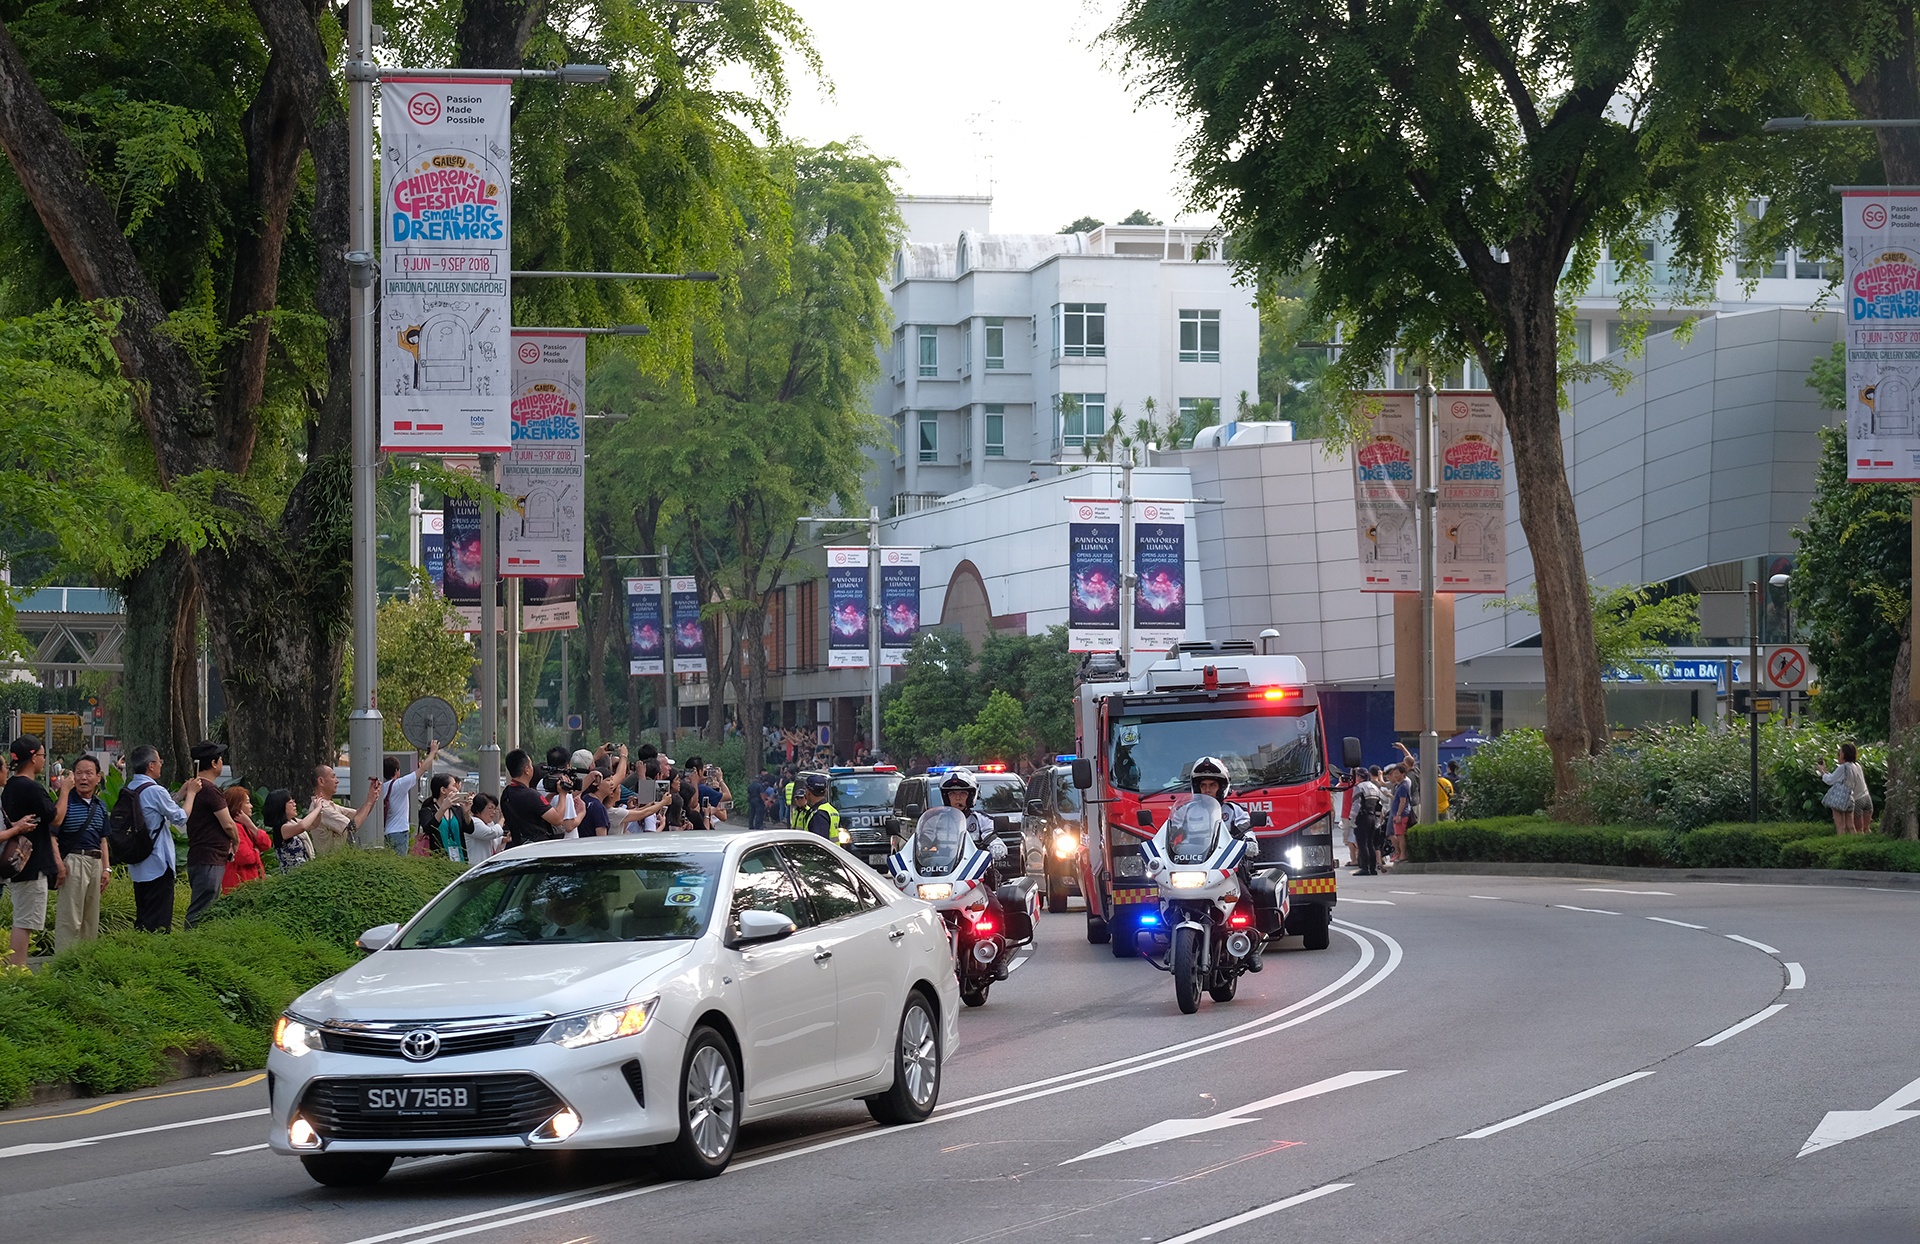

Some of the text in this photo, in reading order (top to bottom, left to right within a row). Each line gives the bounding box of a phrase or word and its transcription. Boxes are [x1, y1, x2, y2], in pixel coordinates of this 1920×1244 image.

[447, 95, 482, 104] Passion
[413, 102, 437, 116] SG
[447, 106, 472, 114] Made
[447, 116, 485, 124] Possible
[463, 204, 499, 222] BIG
[1866, 211, 1884, 222] SG
[403, 257, 490, 271] 9 JUN 9 SEP 2018
[389, 282, 503, 293] NATIONAL GALLERY SINGAPORE
[1905, 290, 1920, 305] BI
[1861, 332, 1866, 342] 9
[1867, 332, 1882, 343] JUN
[1889, 332, 1893, 342] 9
[1895, 331, 1908, 342] SEP
[521, 348, 537, 358] SG
[1852, 351, 1903, 360] NATIONAL GALLERY
[554, 416, 577, 428] BIG
[515, 451, 571, 460] 9 JUN 9 SEP 2018
[1392, 461, 1410, 471] BIG
[1480, 460, 1499, 471] BIG
[1684, 668, 1695, 677] DA
[921, 865, 948, 873] POLICE
[676, 894, 691, 902] P2
